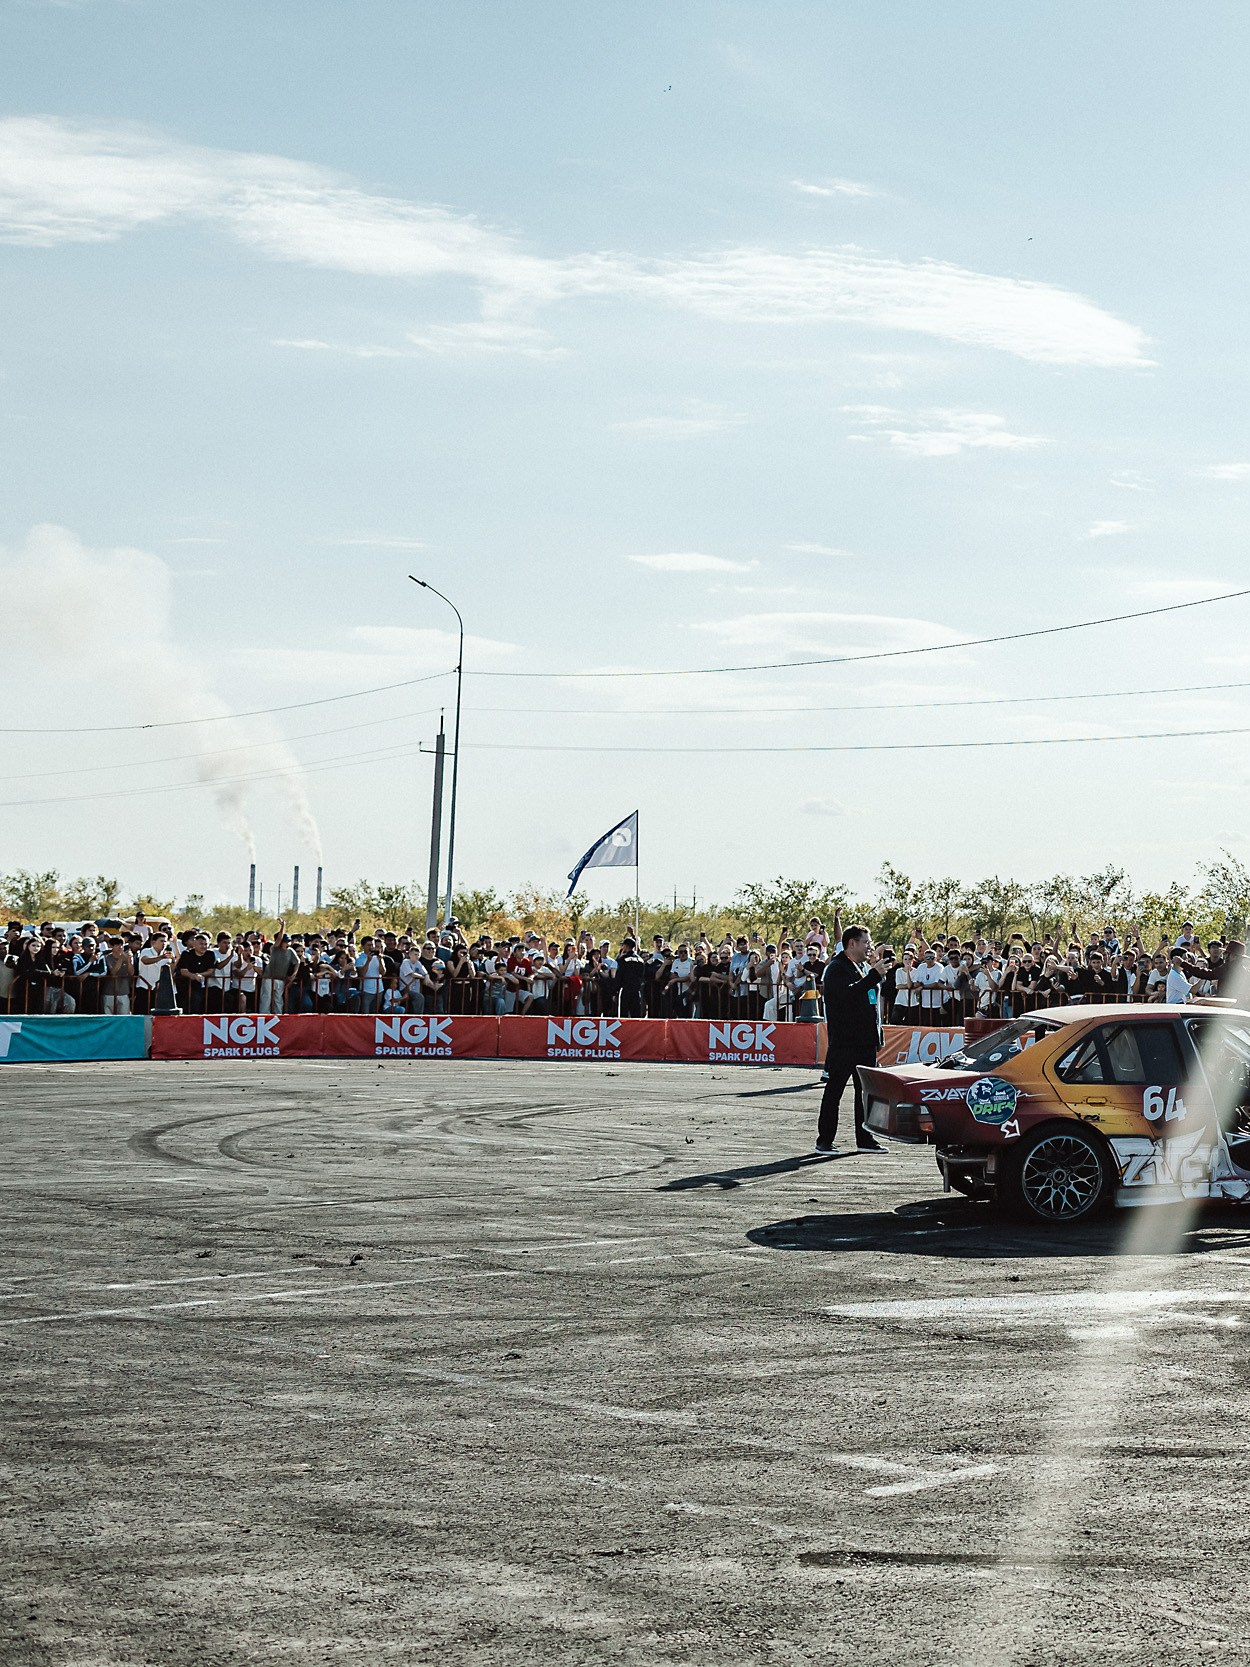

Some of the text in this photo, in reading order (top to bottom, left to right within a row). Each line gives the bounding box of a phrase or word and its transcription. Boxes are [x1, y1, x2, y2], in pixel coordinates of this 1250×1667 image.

[203, 1017, 281, 1045] NGK
[375, 1017, 453, 1045] NGK
[547, 1019, 622, 1047] NGK
[708, 1023, 776, 1051] NGK
[203, 1046, 280, 1057] SPARK PLUGS
[375, 1046, 452, 1056] SPARK PLUGS
[547, 1048, 621, 1059] SPARK PLUGS
[708, 1051, 775, 1063] SPARK PLUGS
[1143, 1086, 1188, 1121] 64
